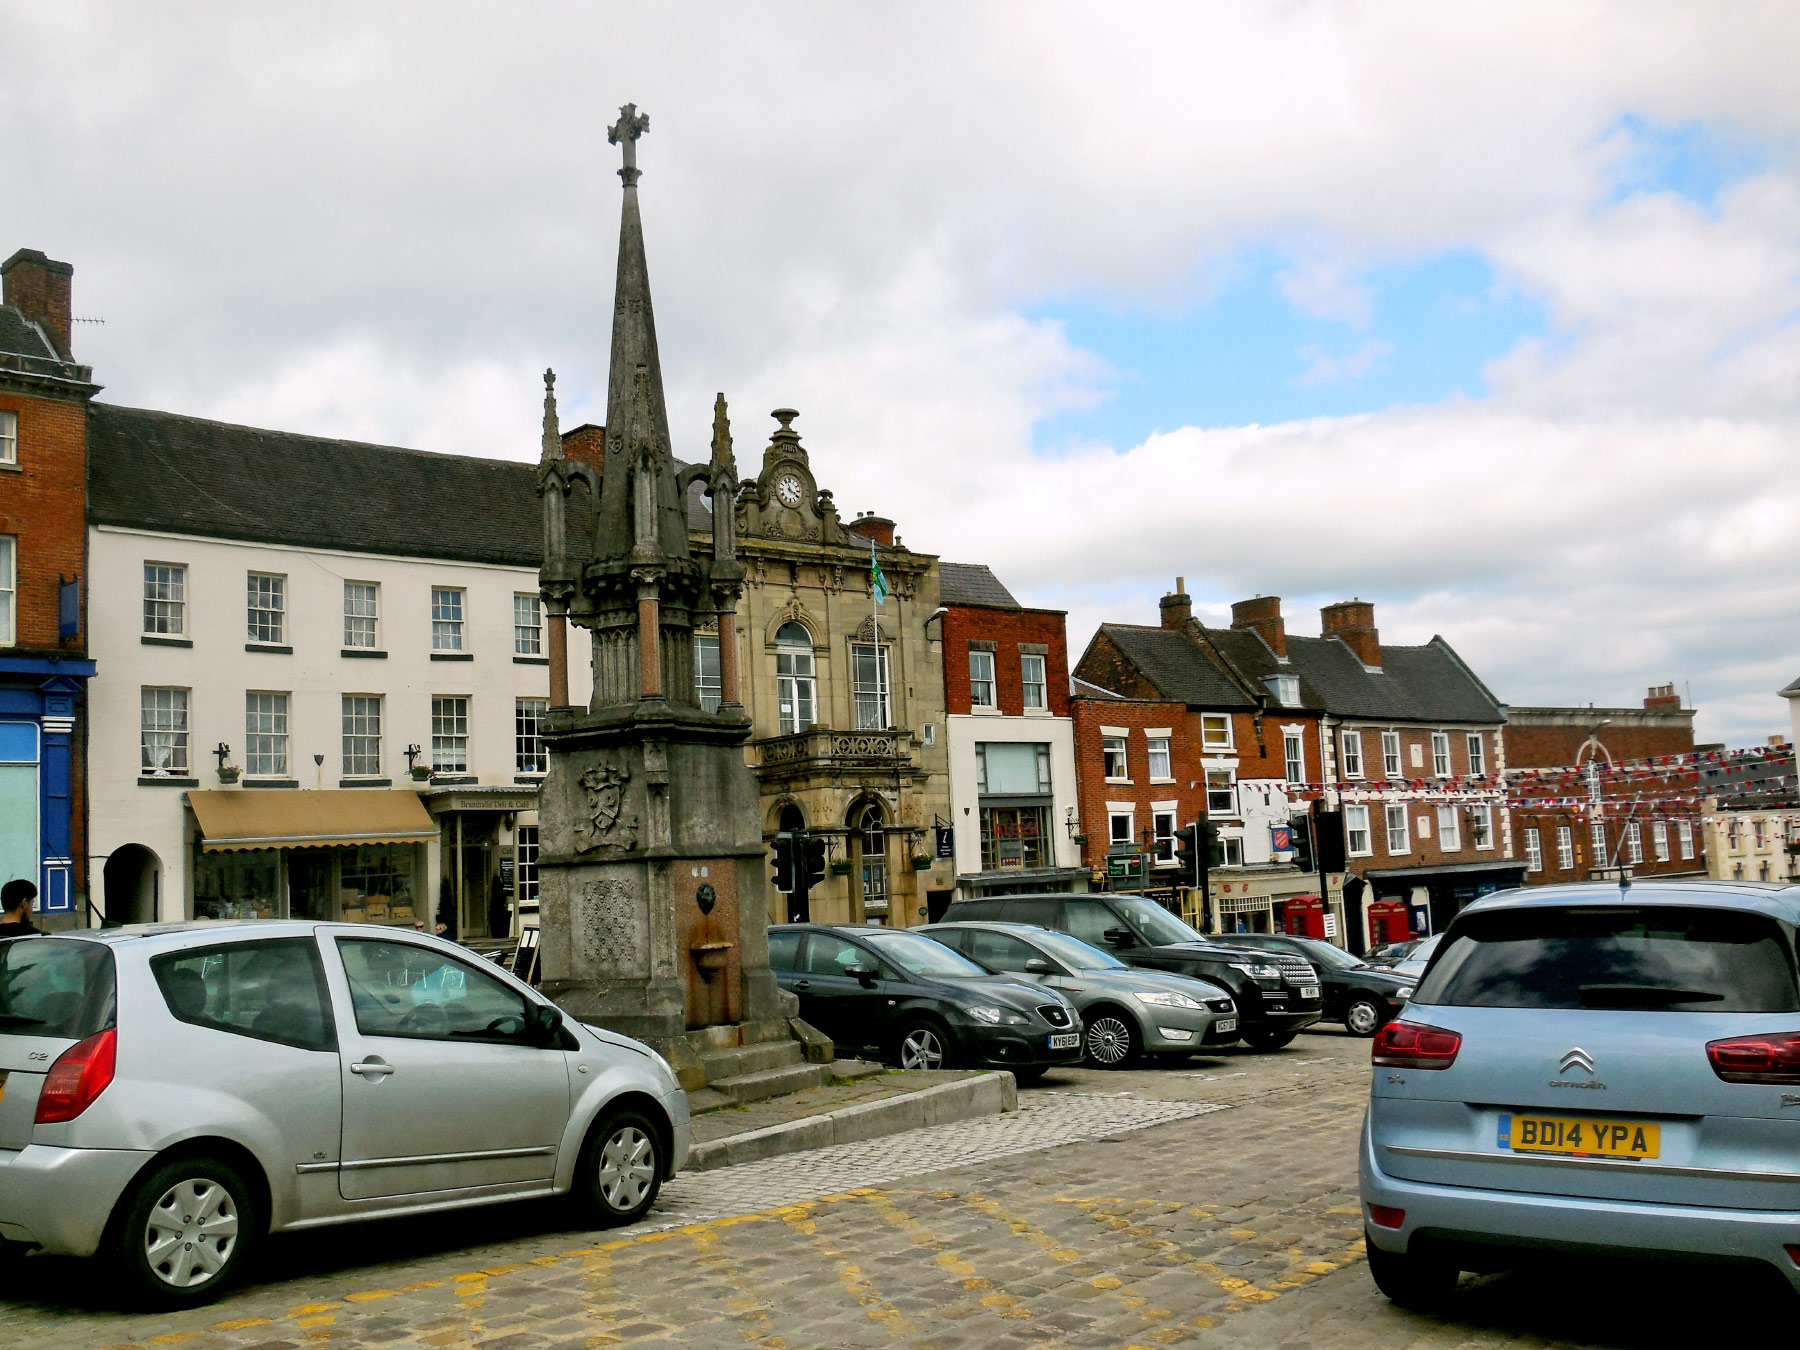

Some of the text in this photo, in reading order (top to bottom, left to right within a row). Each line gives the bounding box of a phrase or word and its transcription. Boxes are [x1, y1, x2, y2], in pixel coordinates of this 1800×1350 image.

[495, 800, 507, 808] Deli
[515, 800, 530, 808] Café
[995, 822, 1039, 837] ALESSI
[29, 1051, 49, 1061] C2
[1520, 1120, 1648, 1152] BD14 YPA
